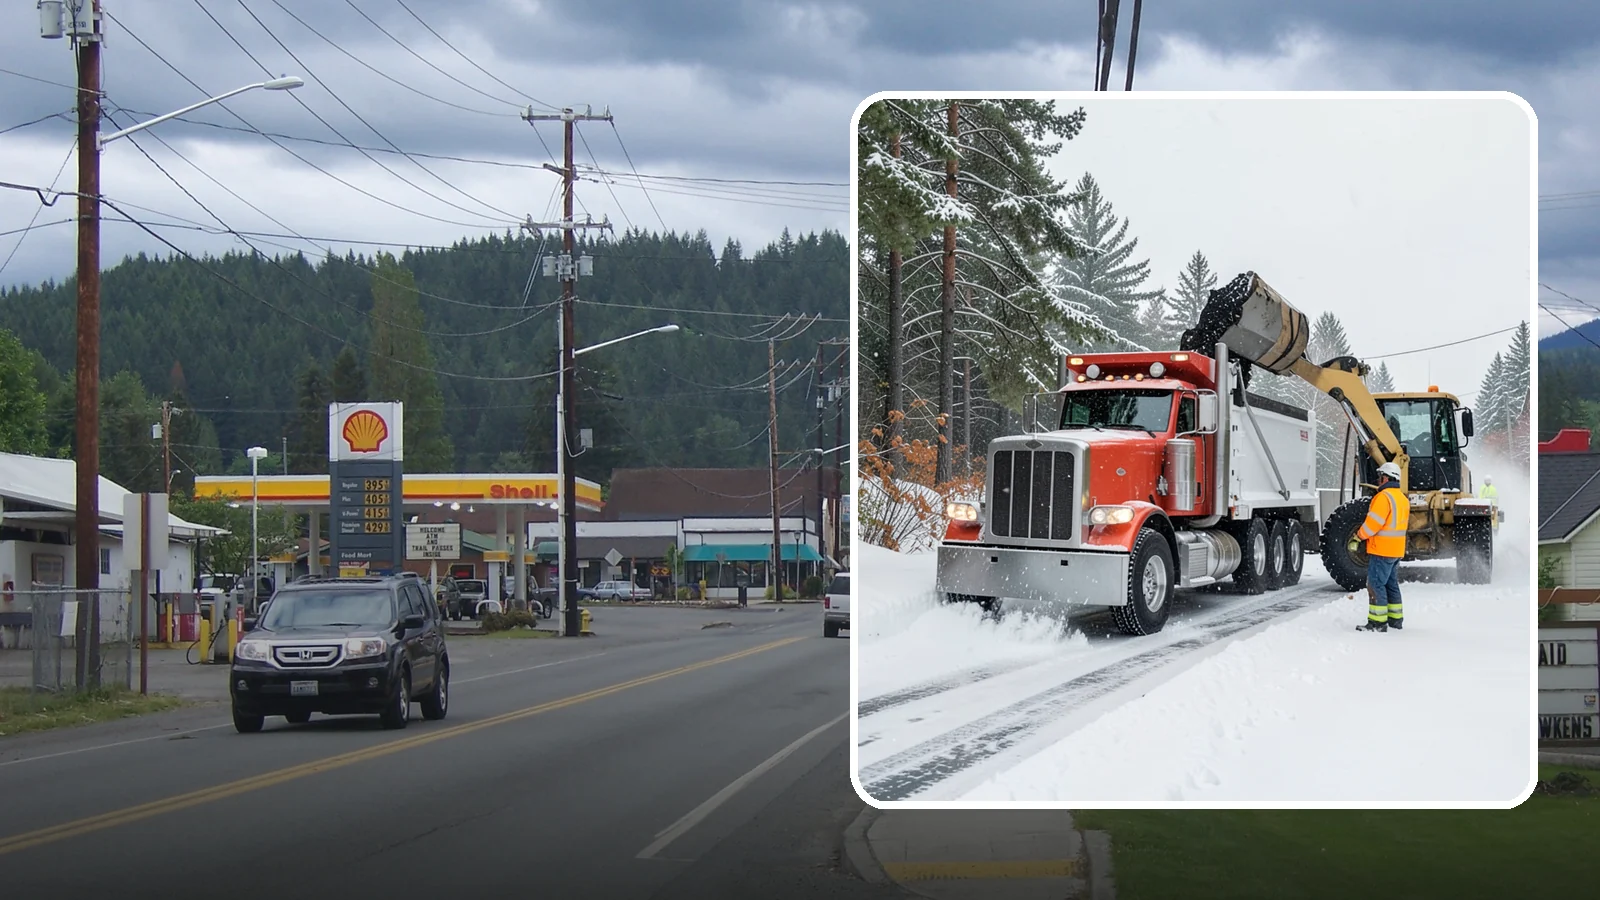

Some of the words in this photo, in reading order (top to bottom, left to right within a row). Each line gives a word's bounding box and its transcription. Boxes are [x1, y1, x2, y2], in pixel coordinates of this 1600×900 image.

[365, 480, 383, 490] 395
[490, 484, 547, 499] Shell
[365, 494, 383, 504] 405
[365, 508, 383, 518] 415
[365, 522, 383, 532] 429
